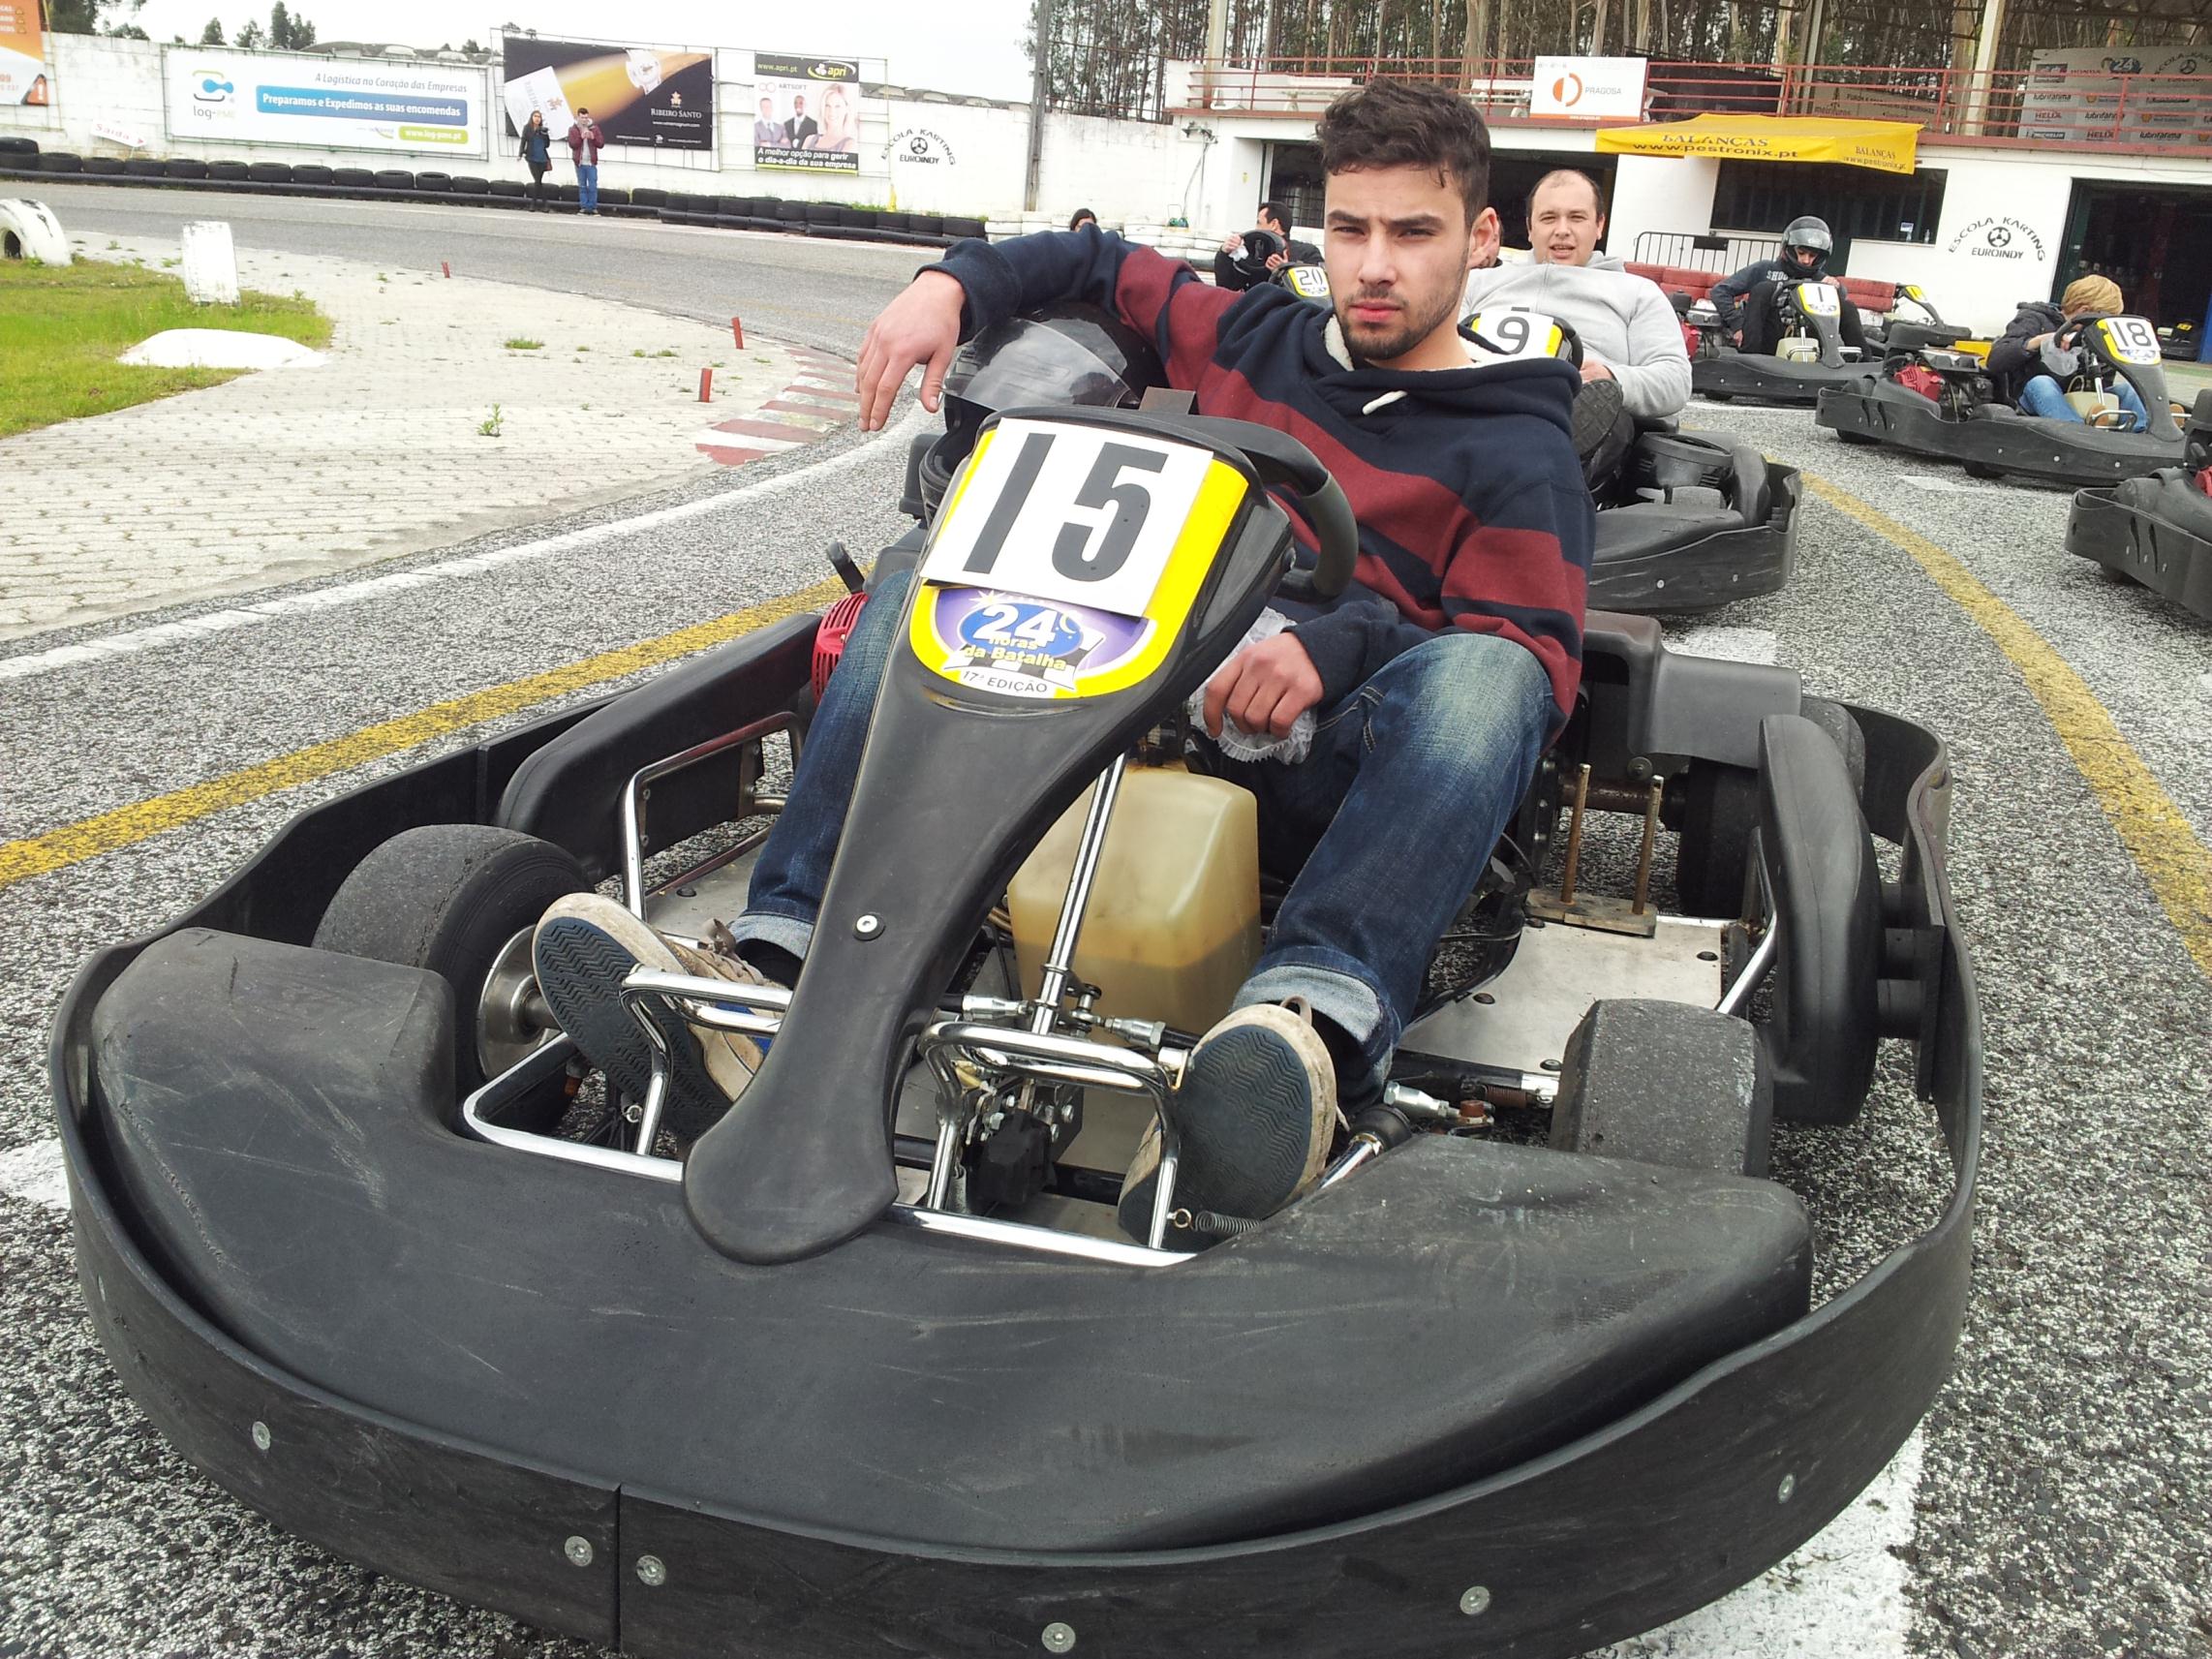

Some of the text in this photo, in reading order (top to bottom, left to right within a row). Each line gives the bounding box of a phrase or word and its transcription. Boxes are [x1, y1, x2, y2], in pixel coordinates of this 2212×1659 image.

[757, 63, 798, 74] www.apri.pt
[827, 66, 847, 77] apri
[315, 73, 322, 82] A
[362, 77, 374, 86] no
[375, 77, 410, 90] Coração
[411, 79, 425, 90] das
[427, 80, 468, 93] Empresas
[1584, 86, 1622, 95] PRAGOSA
[262, 93, 317, 107] Preparamos
[325, 98, 373, 110] Expedimos
[374, 103, 384, 111] as
[385, 103, 405, 112] suas
[406, 105, 461, 117] encomendas
[650, 108, 702, 119] RIBEIRO SANTO
[790, 150, 813, 159] opção
[880, 128, 956, 166] ESCOLA KARTING
[1633, 142, 1798, 159] www.pestronix.pt
[1855, 146, 1896, 160] BALANÇAS
[765, 156, 797, 166] dia-a-dia
[899, 154, 939, 165] EUROINDY
[1948, 216, 2046, 261] ESCOLA KARTING
[1971, 247, 2024, 260] EUROINDY
[1295, 268, 1323, 287] 20
[1817, 286, 1824, 302] 1
[1496, 316, 1530, 354] 9
[2113, 321, 2152, 347] 18
[963, 432, 1169, 583] 15
[972, 603, 1059, 648] 24
[989, 634, 1038, 650] horas
[965, 644, 1066, 671] da Batalha
[987, 677, 1048, 693] EDIÇÃO
